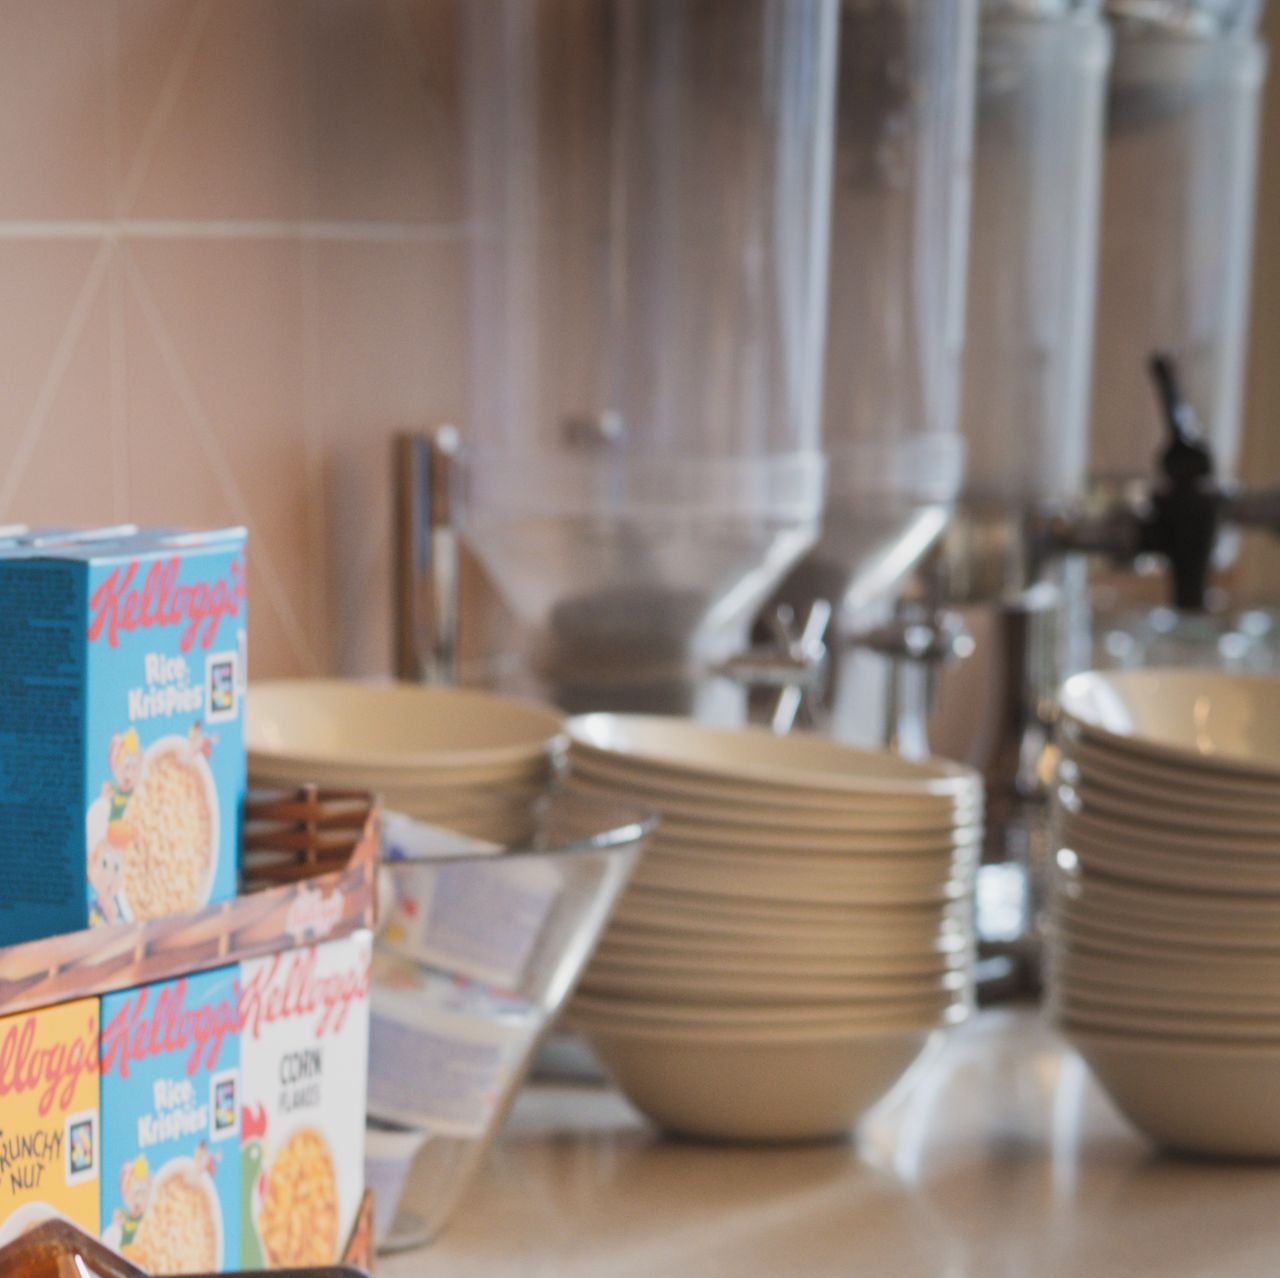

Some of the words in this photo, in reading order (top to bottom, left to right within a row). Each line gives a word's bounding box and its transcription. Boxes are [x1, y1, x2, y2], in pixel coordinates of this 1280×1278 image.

[87, 555, 246, 653] Kellogg's
[145, 653, 189, 686] Rice
[127, 683, 204, 721] Krispies
[238, 944, 372, 1040] Kellogg's
[99, 977, 244, 1079] Kellogg's
[278, 1048, 323, 1086] CORN
[153, 1078, 196, 1112] Rice
[137, 1105, 208, 1148] Krispies
[10, 1163, 46, 1195] NUT
